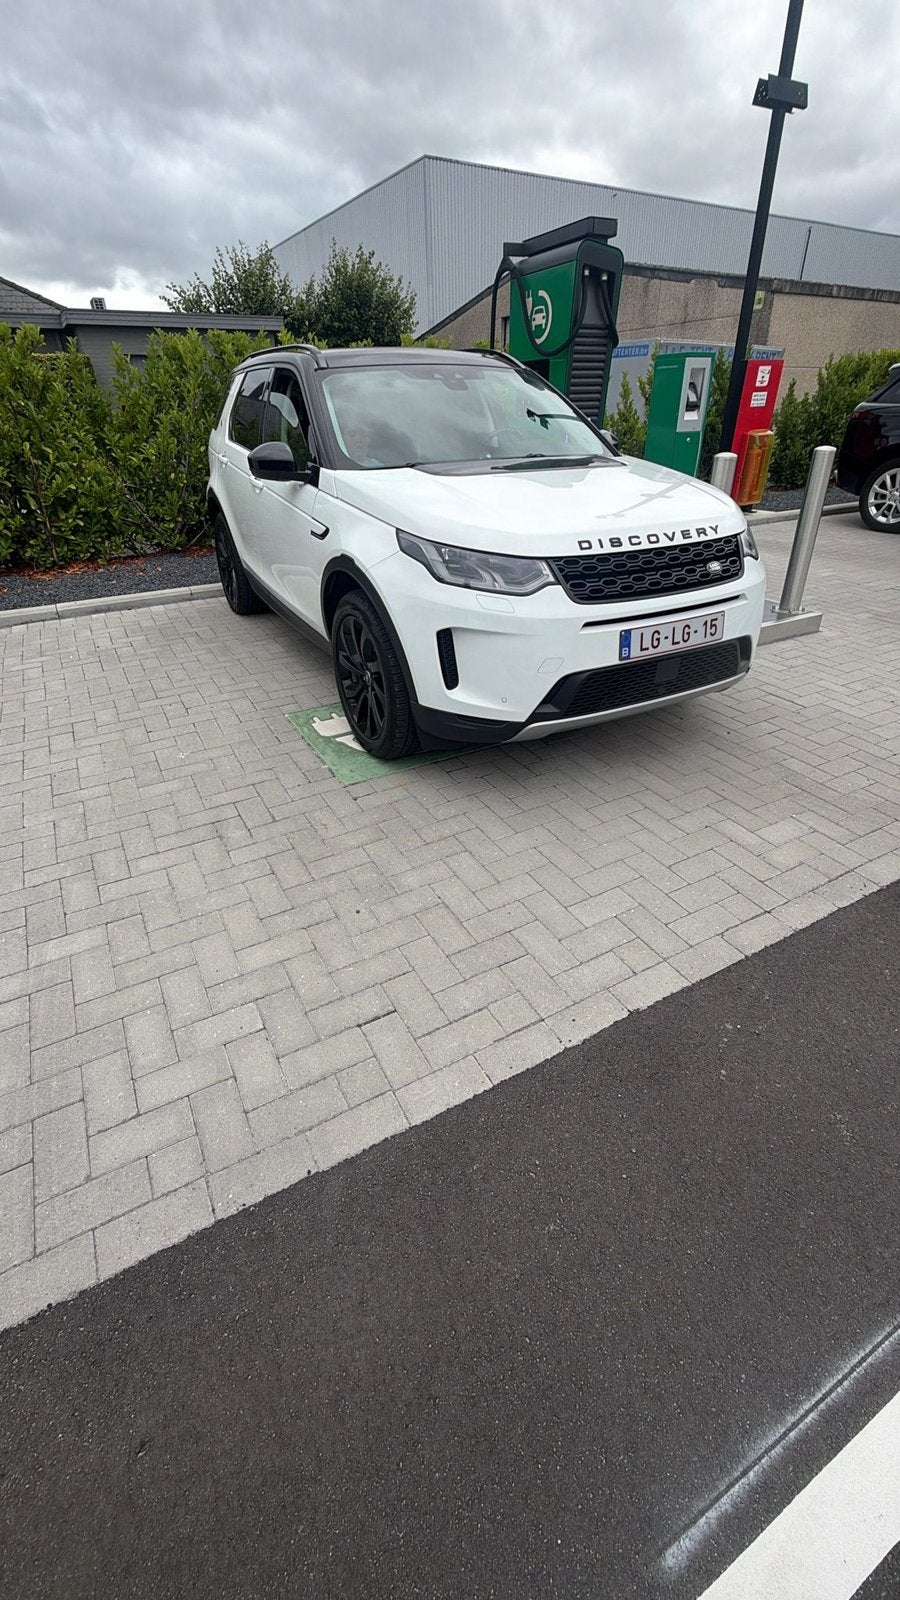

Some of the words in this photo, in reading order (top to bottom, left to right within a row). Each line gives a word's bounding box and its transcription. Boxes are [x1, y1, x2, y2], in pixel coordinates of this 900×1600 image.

[577, 525, 719, 551] DISCOVERY
[639, 617, 718, 652] LG-LG-15
[621, 647, 629, 657] B
